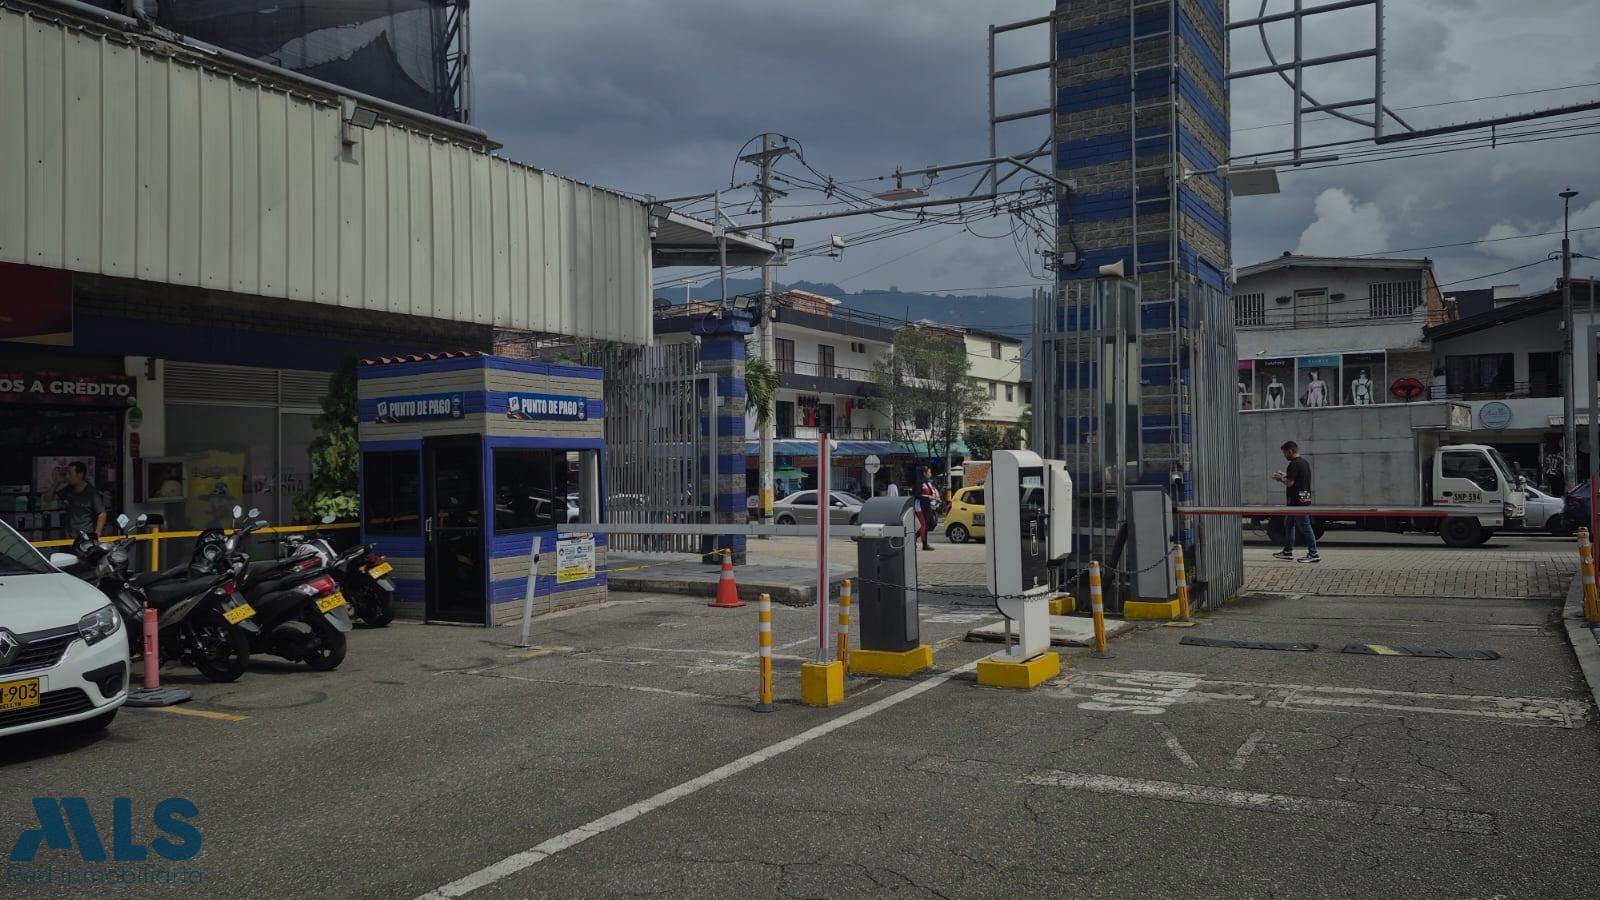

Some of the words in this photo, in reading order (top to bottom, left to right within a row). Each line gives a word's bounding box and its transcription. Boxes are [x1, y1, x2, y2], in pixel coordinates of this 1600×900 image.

[30, 380, 45, 393] A
[50, 378, 130, 397] CRÉDITO
[389, 401, 416, 418] PUNTO
[417, 400, 428, 416] DE
[429, 398, 451, 415] PAGO
[521, 398, 547, 415] PUNTO
[548, 400, 558, 414] DE
[558, 400, 578, 416] PAGO
